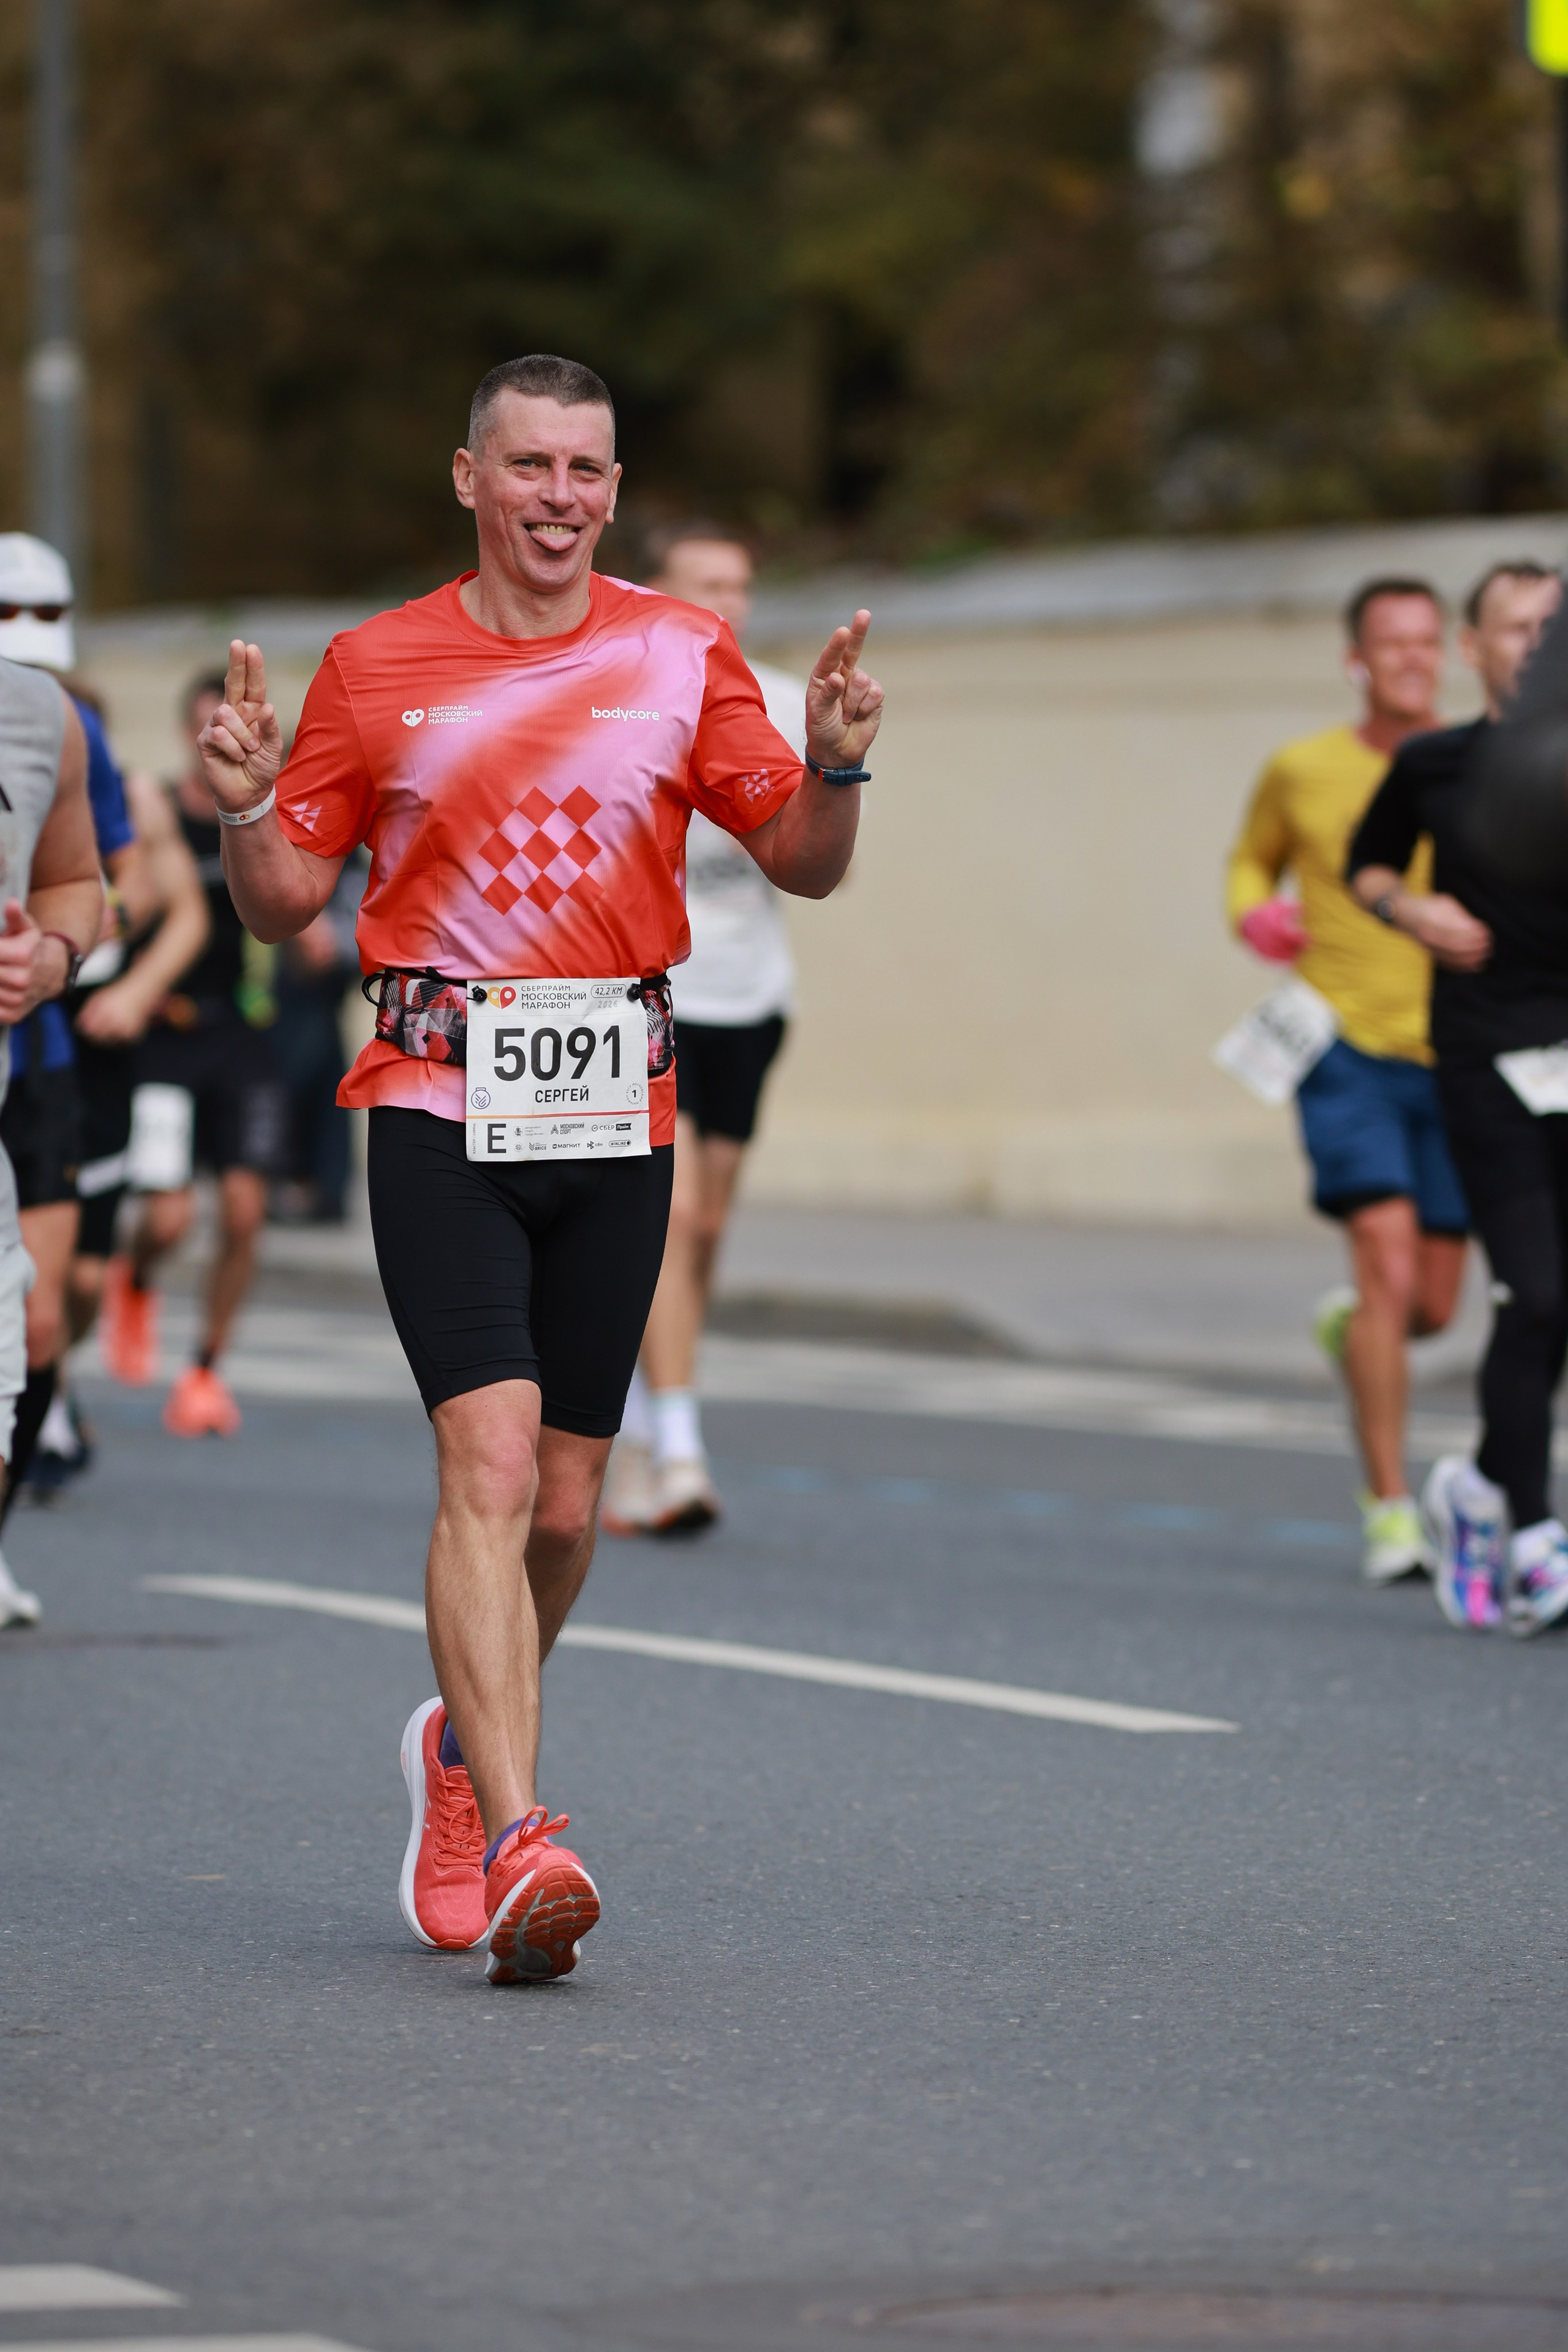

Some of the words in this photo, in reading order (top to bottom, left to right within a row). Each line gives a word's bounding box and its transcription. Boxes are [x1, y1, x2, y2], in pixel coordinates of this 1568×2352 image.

[428, 710, 483, 718] МОСКОВСКИЙ
[591, 706, 660, 722] bodycore
[521, 992, 587, 1000] МОСКОВСКИЙ
[595, 987, 610, 996] 42,2
[494, 1025, 620, 1081] 5091
[535, 1085, 589, 1103] СЕРГЕЙ
[488, 1123, 507, 1153] E
